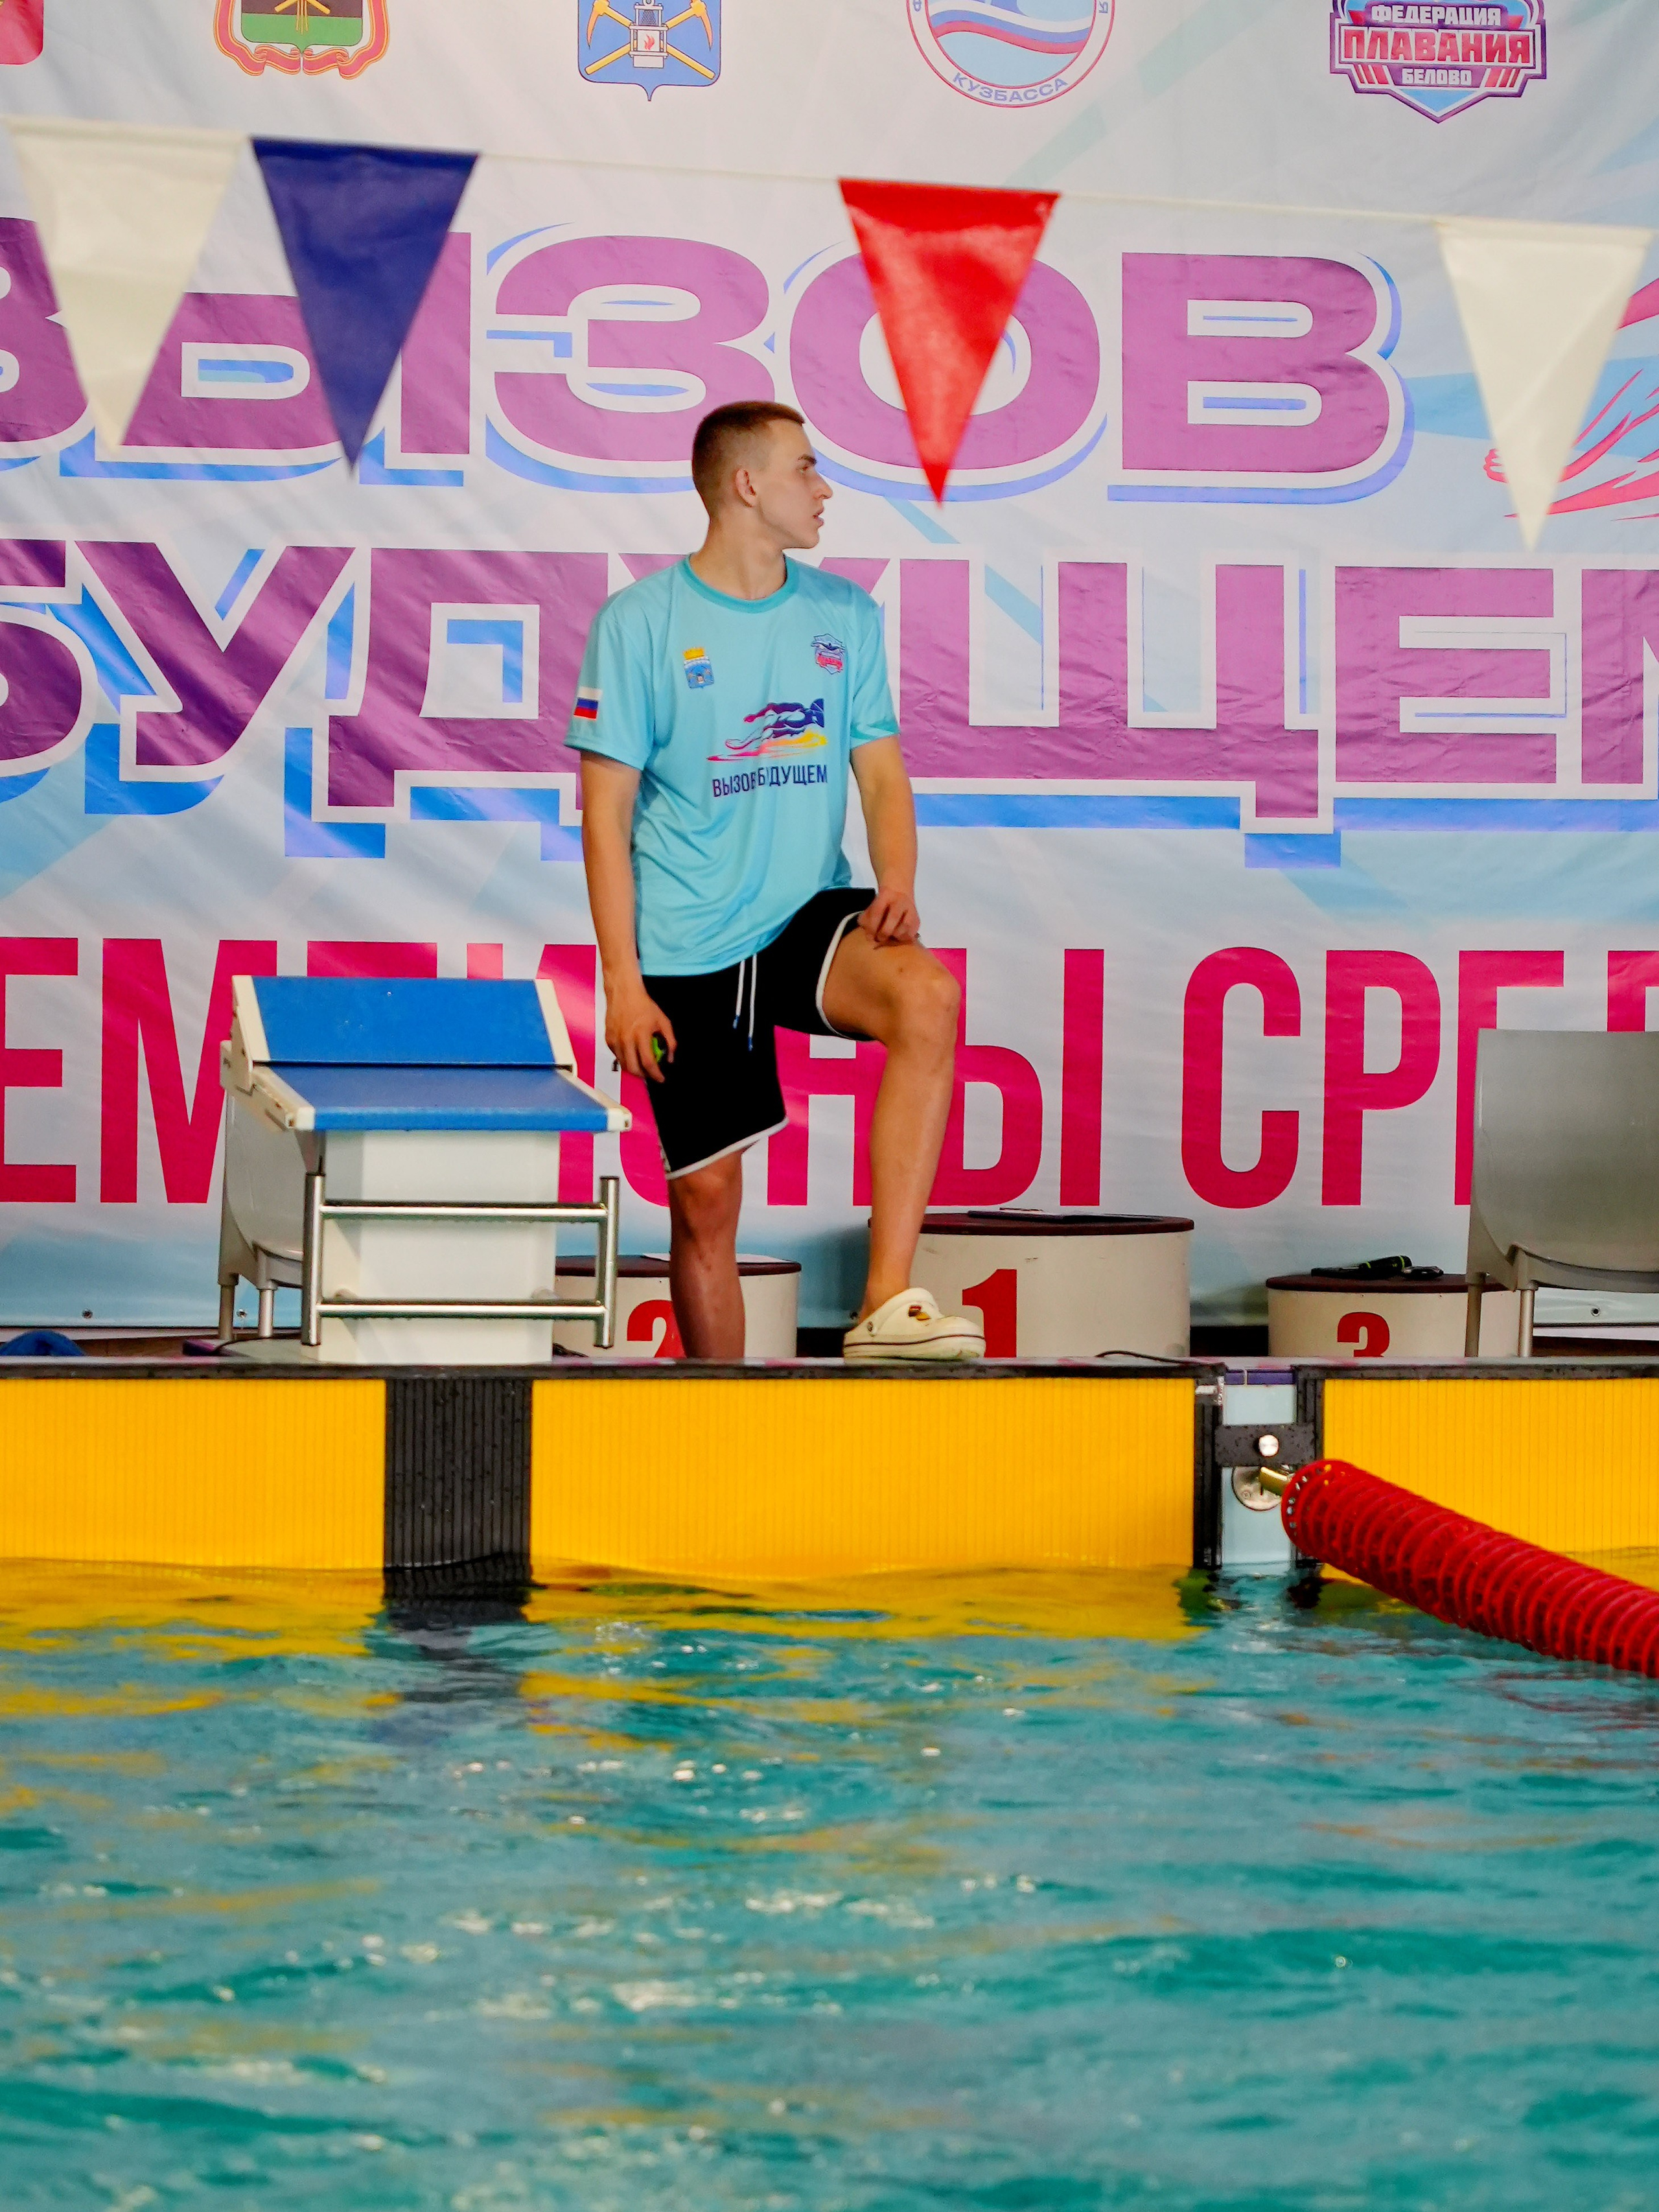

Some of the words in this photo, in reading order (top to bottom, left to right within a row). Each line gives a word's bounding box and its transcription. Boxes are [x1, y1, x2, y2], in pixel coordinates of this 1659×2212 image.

[1371, 5, 1502, 27] ФЕДЕРАЦИЯ
[1343, 29, 1531, 64] ПЛАВАНИЯ
[953, 72, 1068, 102] КУЗБАССА
[1401, 68, 1472, 86] БЕЛОВО
[0, 539, 1659, 819] УДЩЕ
[757, 764, 828, 786] БДУЩЕМ
[962, 1268, 1017, 1358] 1
